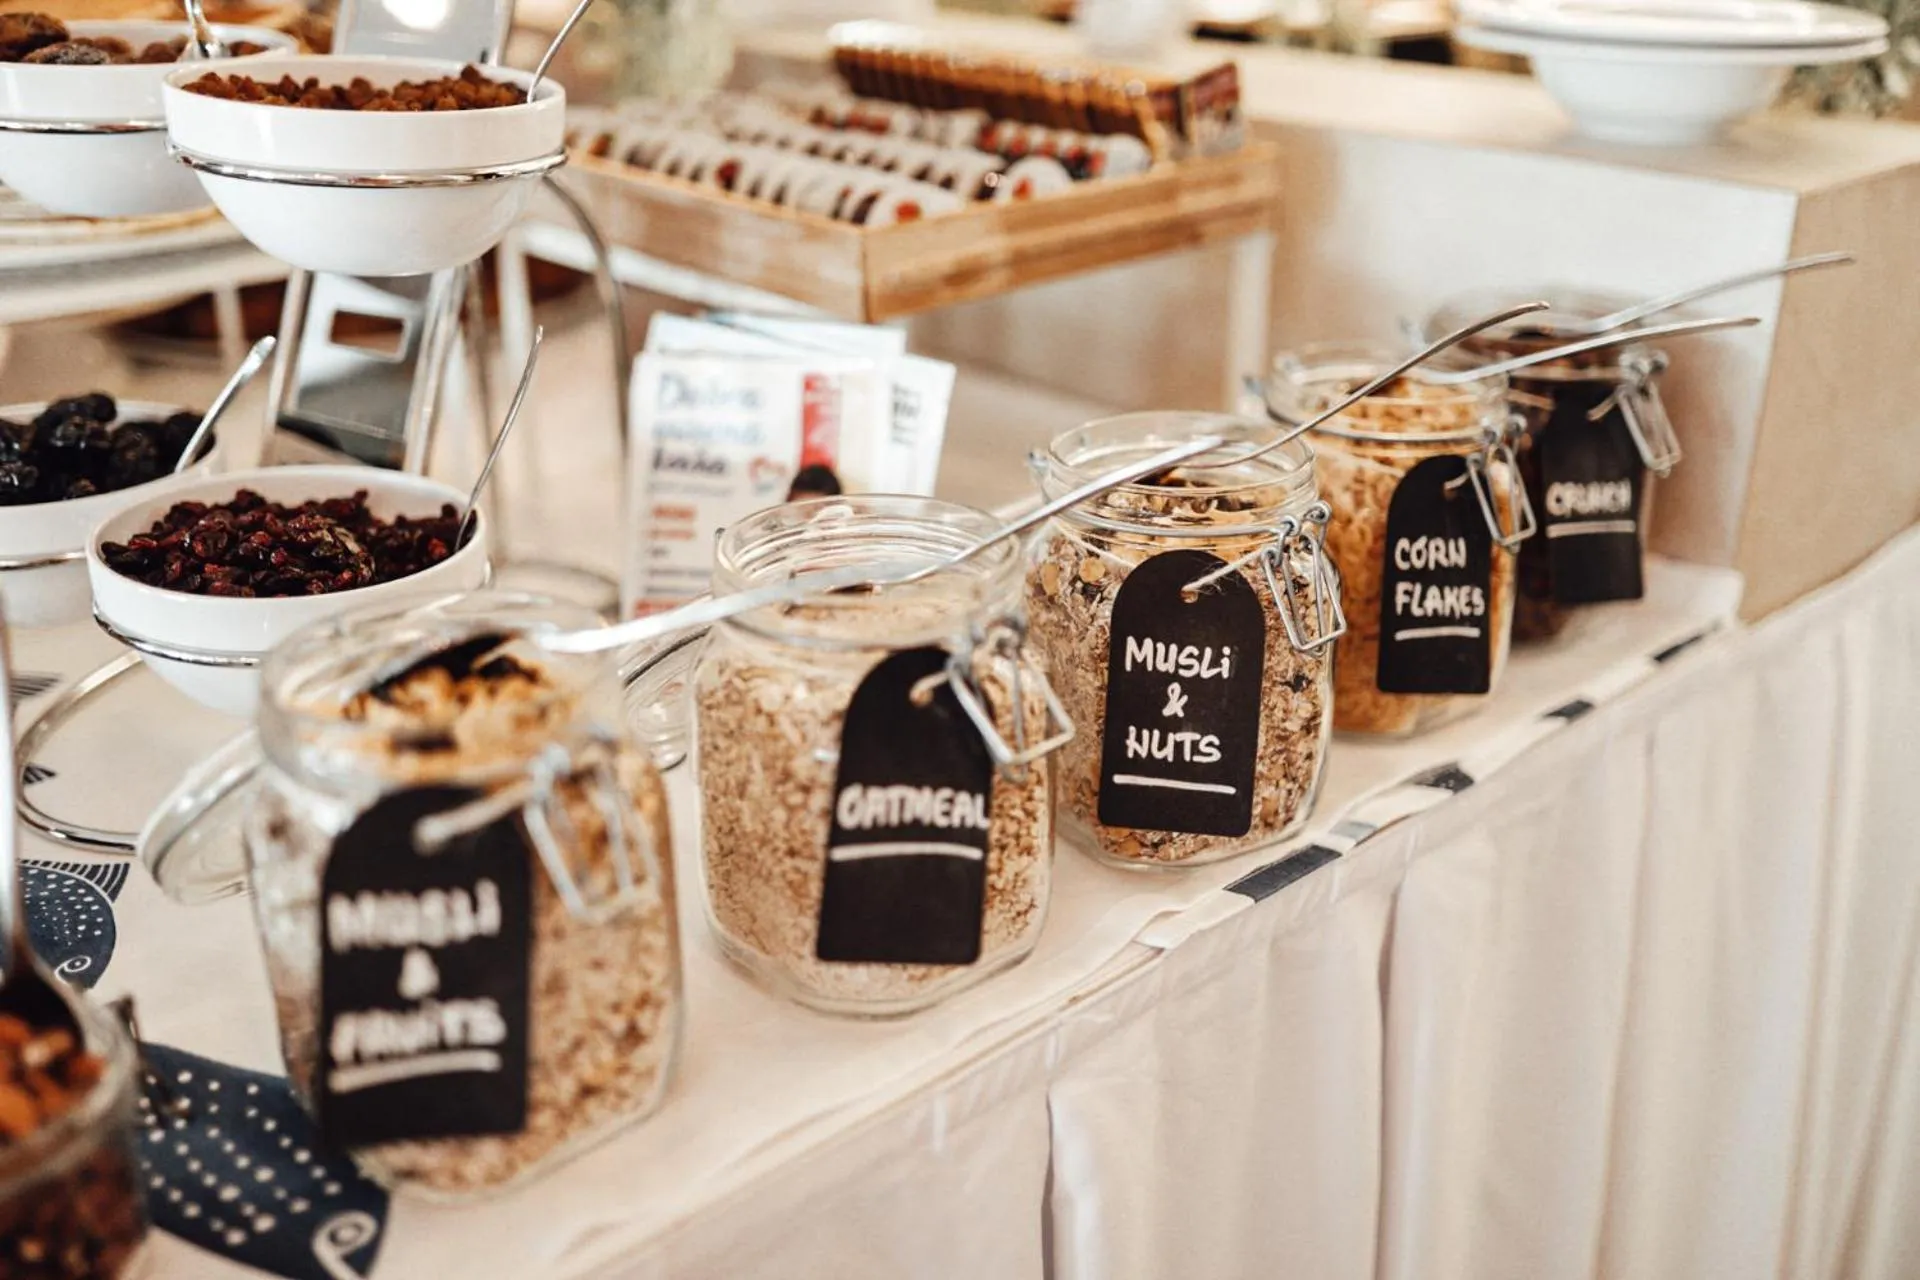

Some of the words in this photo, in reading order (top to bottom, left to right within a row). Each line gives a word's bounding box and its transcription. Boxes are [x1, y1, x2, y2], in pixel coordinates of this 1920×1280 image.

[1395, 535, 1467, 571] CORN
[1395, 581, 1485, 619] FLAKES
[1125, 636, 1230, 679] MUSLi
[1162, 682, 1189, 717] &
[1126, 725, 1222, 763] NUTS
[837, 782, 991, 830] OATMEAL
